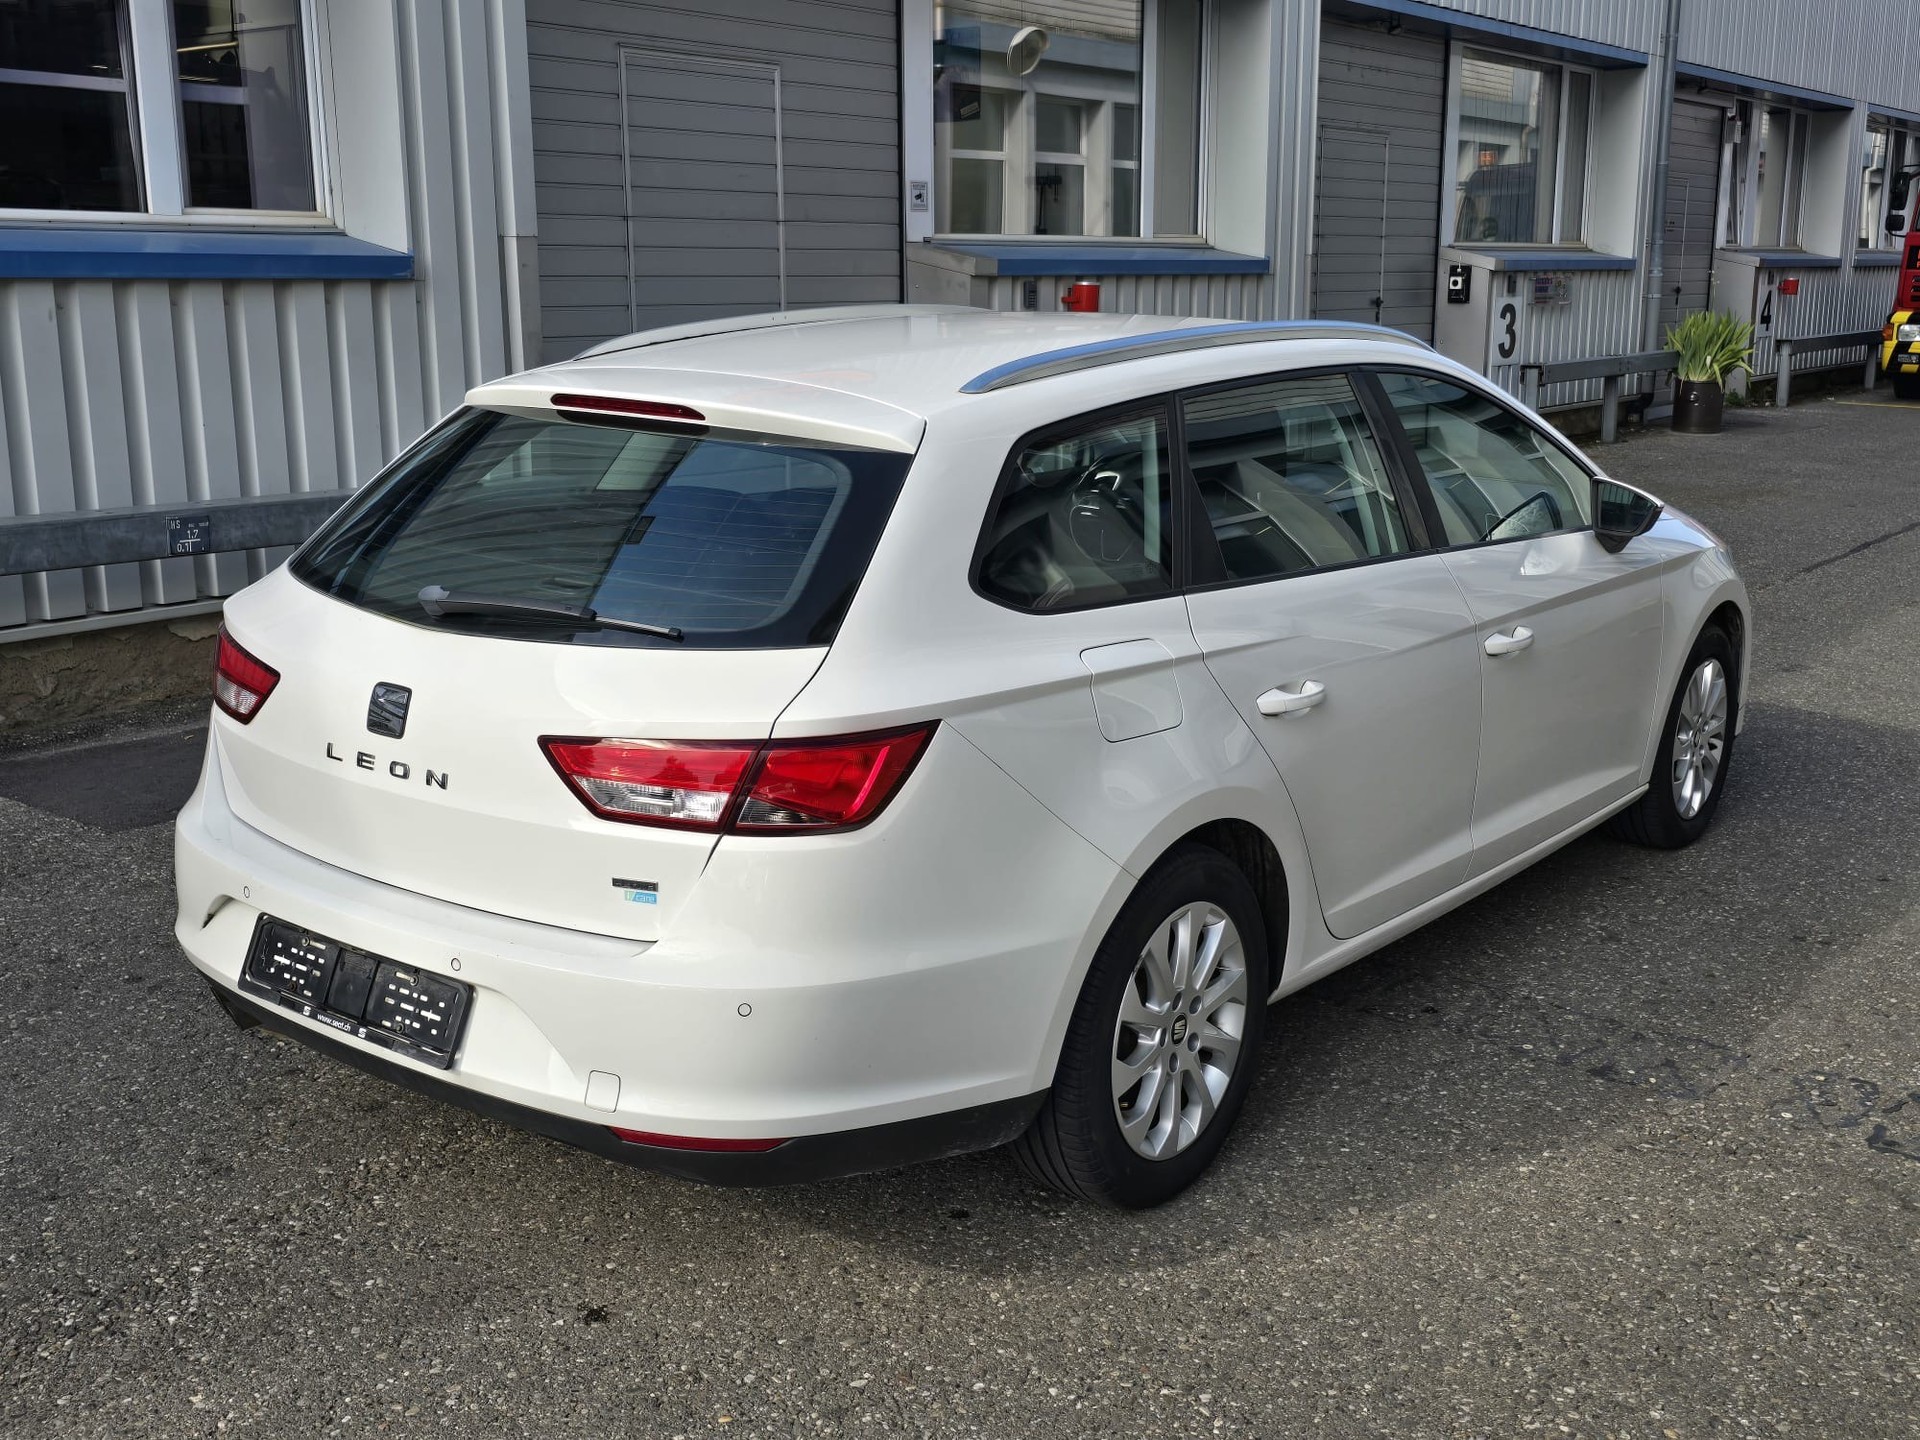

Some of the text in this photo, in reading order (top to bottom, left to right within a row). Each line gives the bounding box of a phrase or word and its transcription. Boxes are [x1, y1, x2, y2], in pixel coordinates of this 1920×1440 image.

[1760, 290, 1772, 331] 4
[1498, 303, 1517, 359] 3
[176, 543, 189, 552] 0.1
[187, 529, 199, 539] 1.7
[326, 742, 449, 790] LEON
[317, 1013, 351, 1032] www.seat.ch
